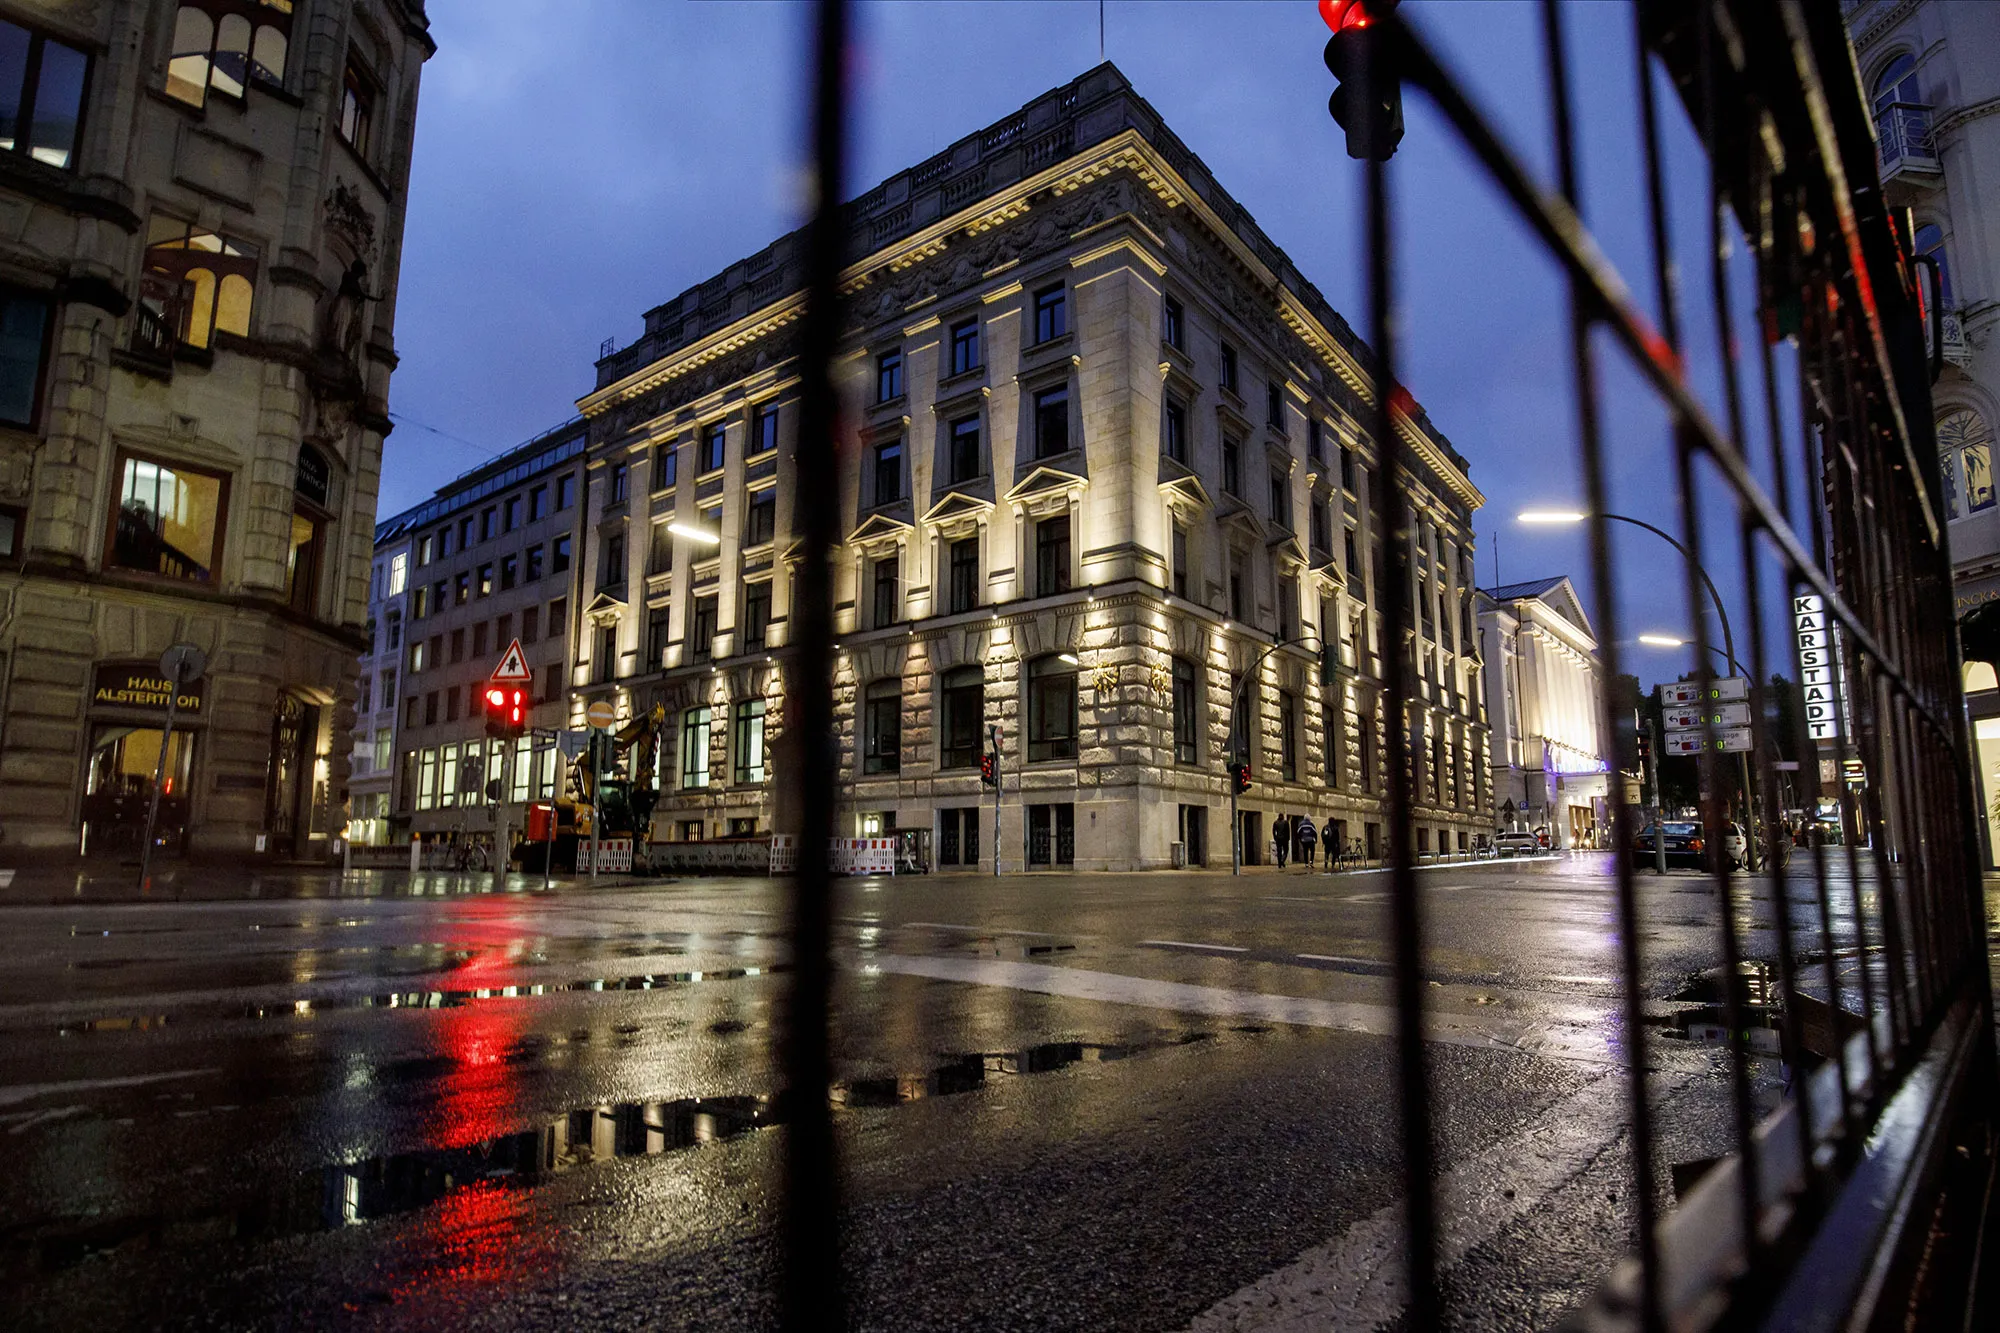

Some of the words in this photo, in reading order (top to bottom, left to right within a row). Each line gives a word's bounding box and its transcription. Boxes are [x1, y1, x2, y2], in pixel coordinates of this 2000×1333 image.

[1956, 591, 1989, 608] INCK
[1795, 598, 1826, 737] KARSTADT
[127, 676, 173, 692] HAUS
